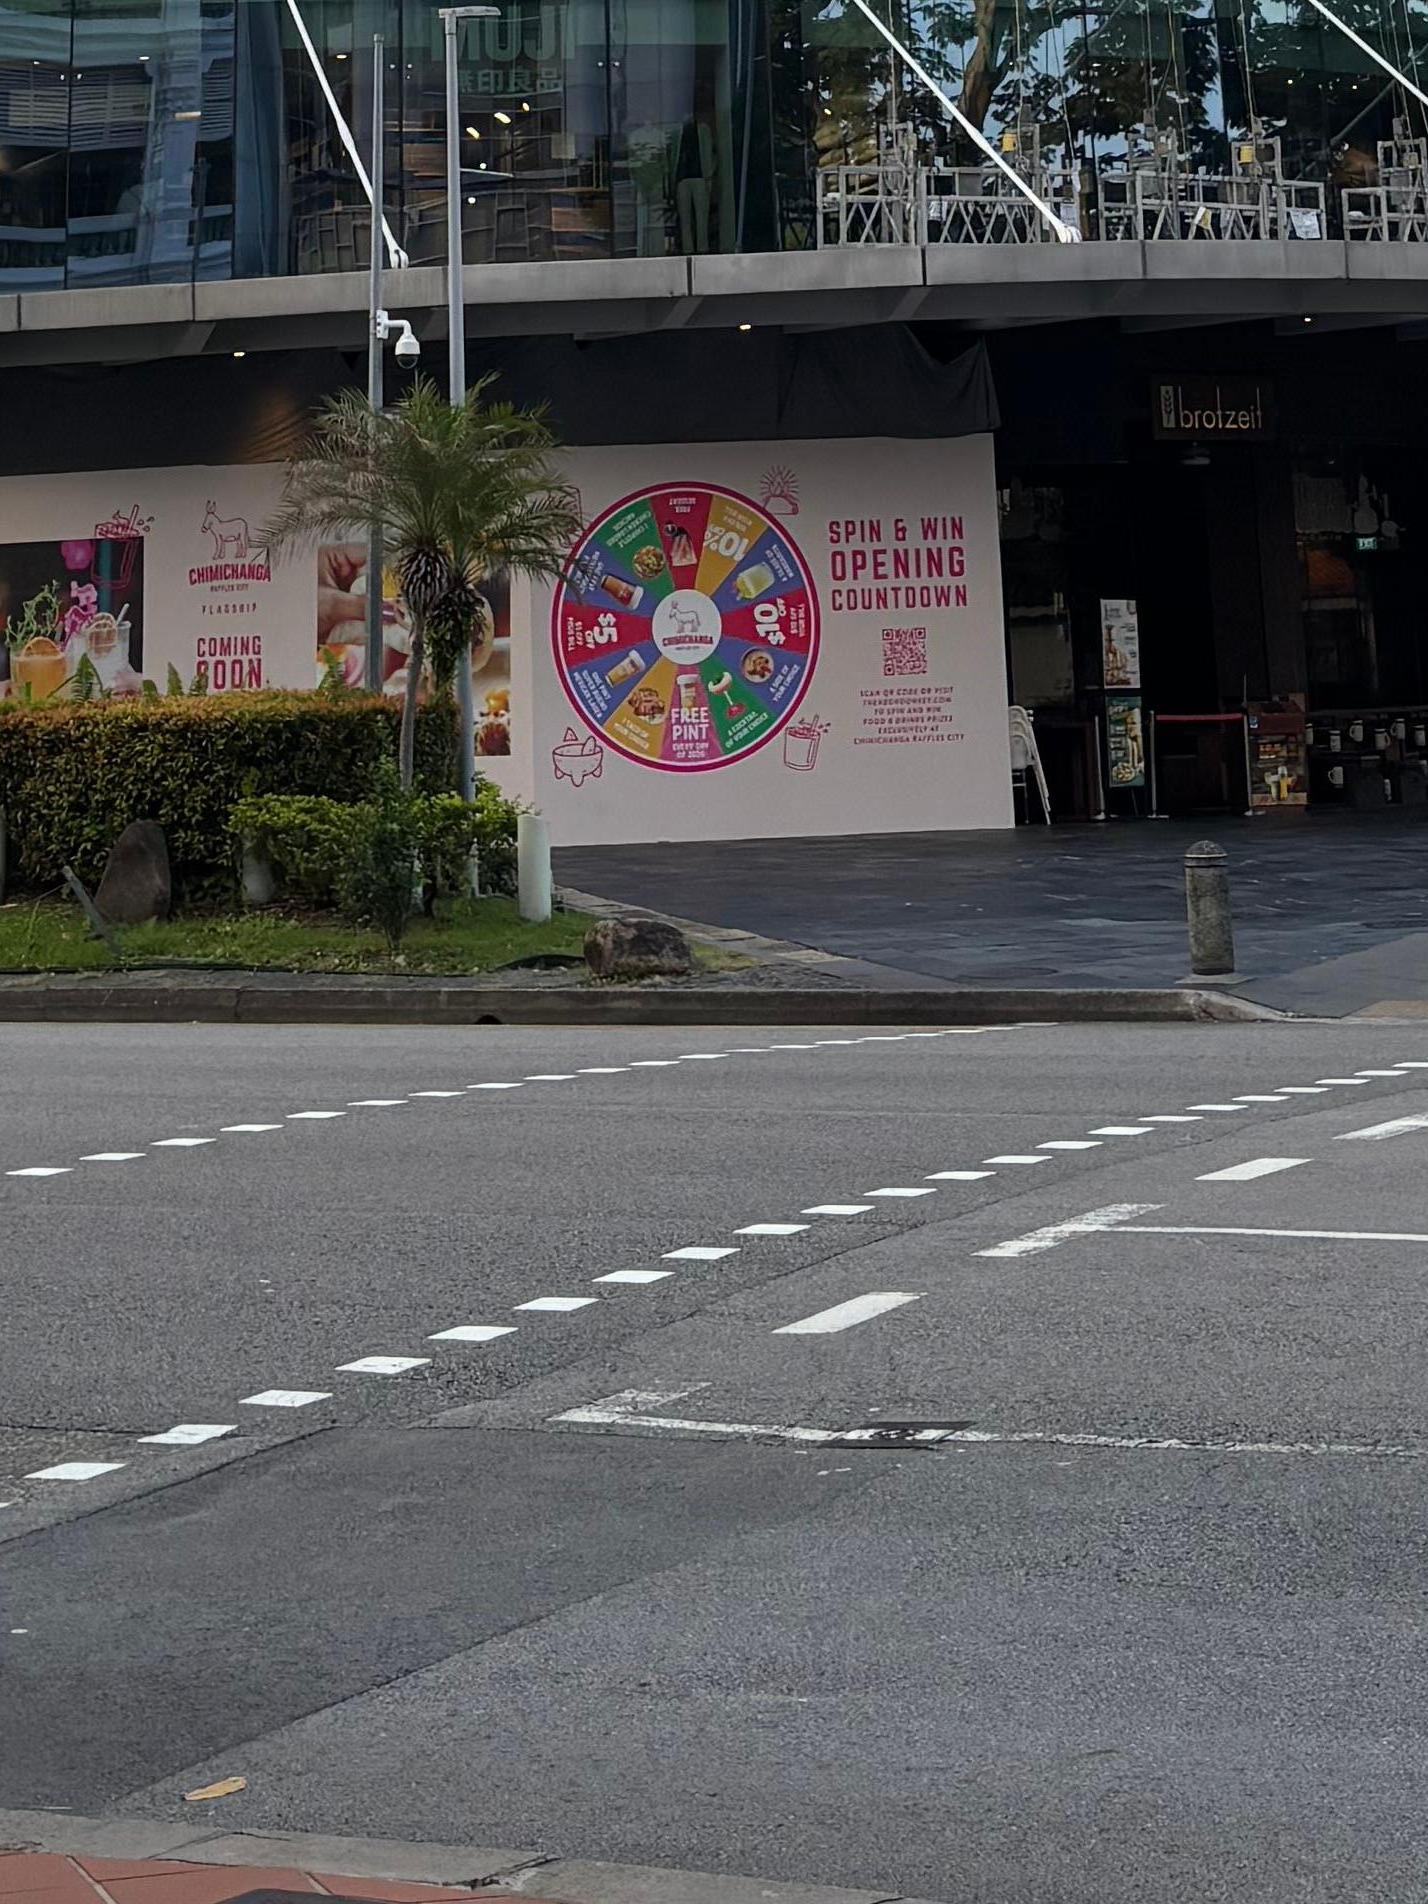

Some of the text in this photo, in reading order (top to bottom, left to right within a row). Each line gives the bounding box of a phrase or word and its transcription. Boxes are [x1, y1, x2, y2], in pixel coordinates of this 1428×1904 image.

[1178, 384, 1262, 429] brotzeit
[828, 516, 964, 544] SPIN & WIN
[189, 563, 271, 586] CHIMICHANGA
[830, 546, 965, 582] OPENING
[832, 584, 968, 612] COUNTDOWN
[197, 635, 262, 658] COMING
[671, 706, 710, 724] FREE
[672, 724, 710, 741] PINT
